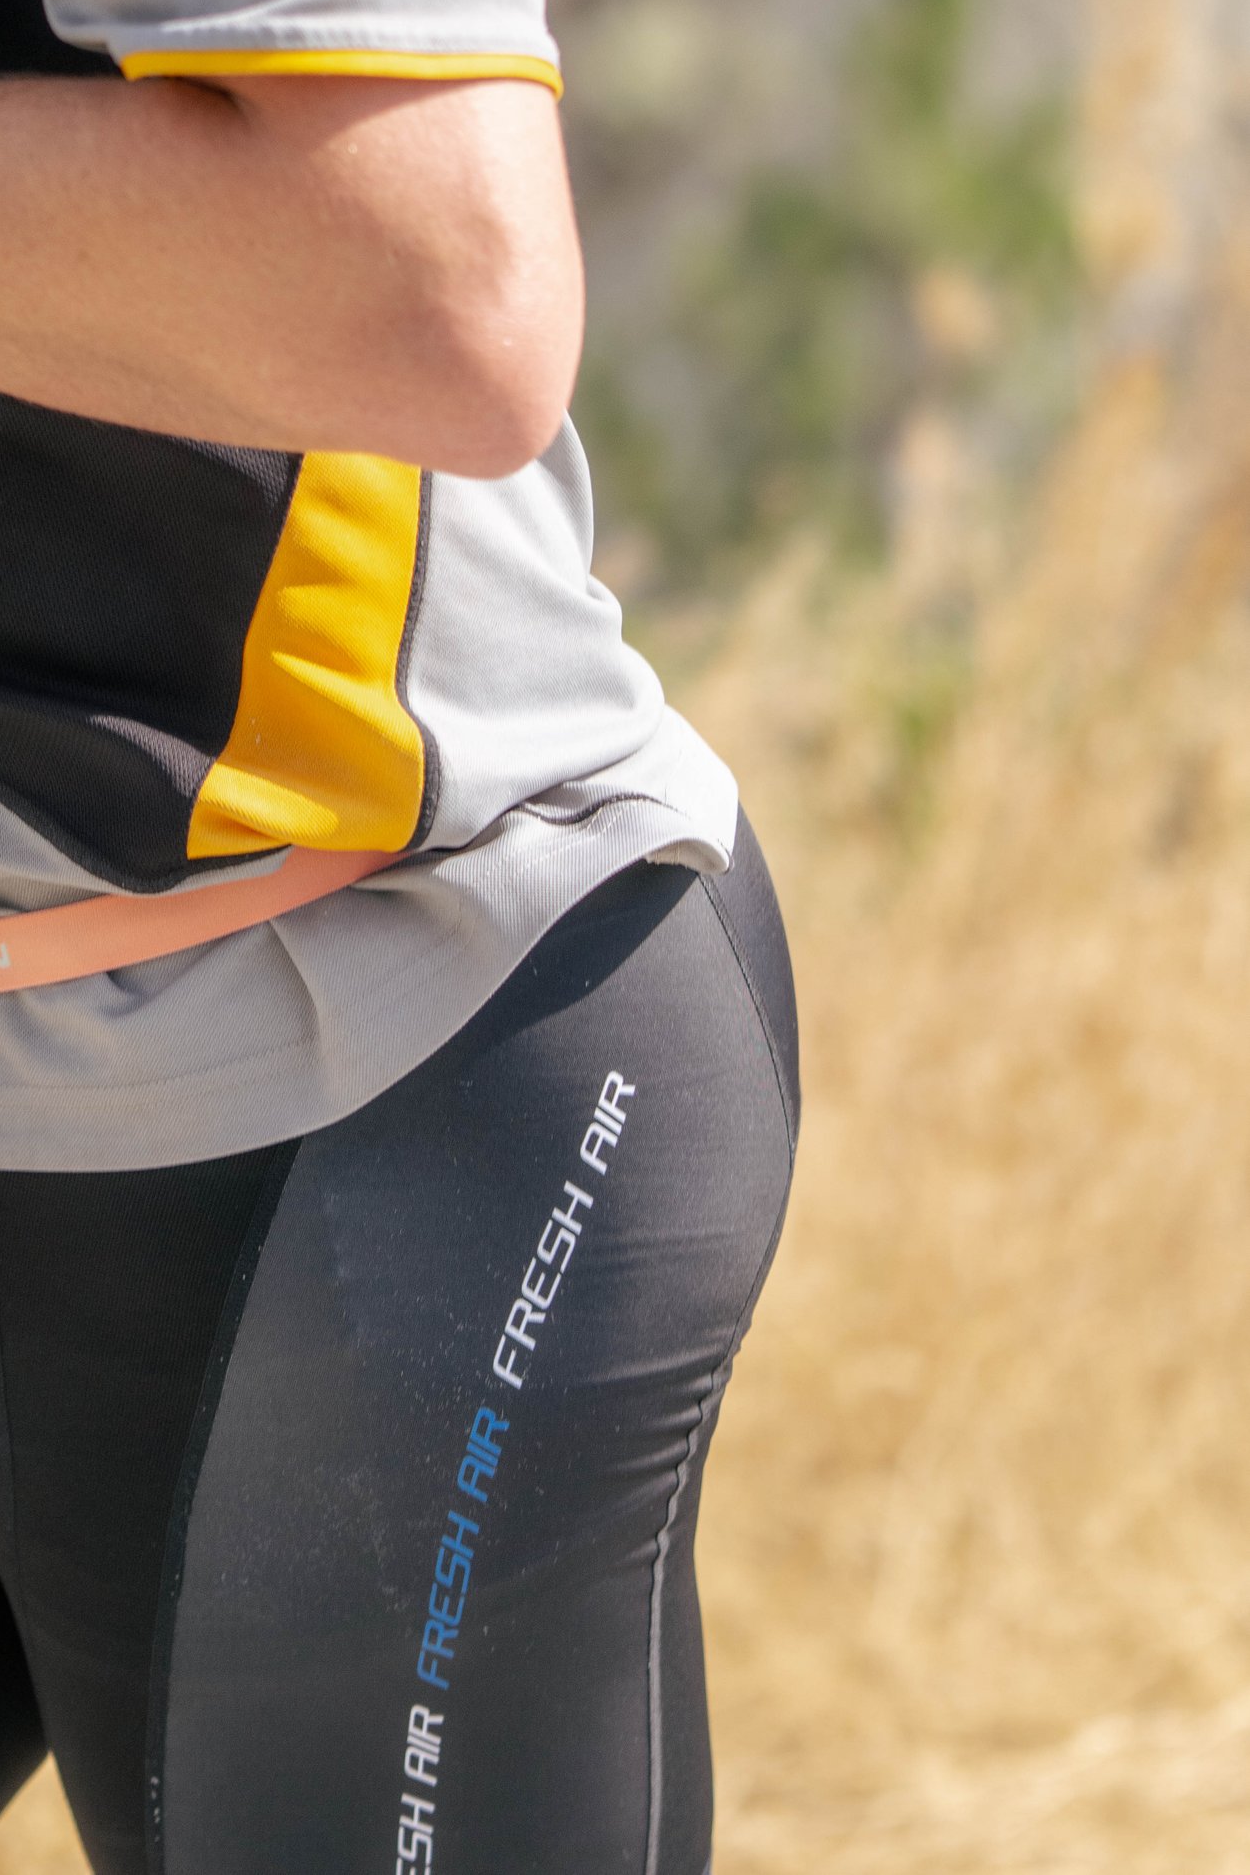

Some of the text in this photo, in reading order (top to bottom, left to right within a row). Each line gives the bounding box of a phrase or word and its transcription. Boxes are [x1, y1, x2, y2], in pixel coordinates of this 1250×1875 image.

[493, 1069, 637, 1390] FRESH AIR
[415, 1406, 511, 1691] FRESH AIR
[404, 1703, 445, 1788] AIR
